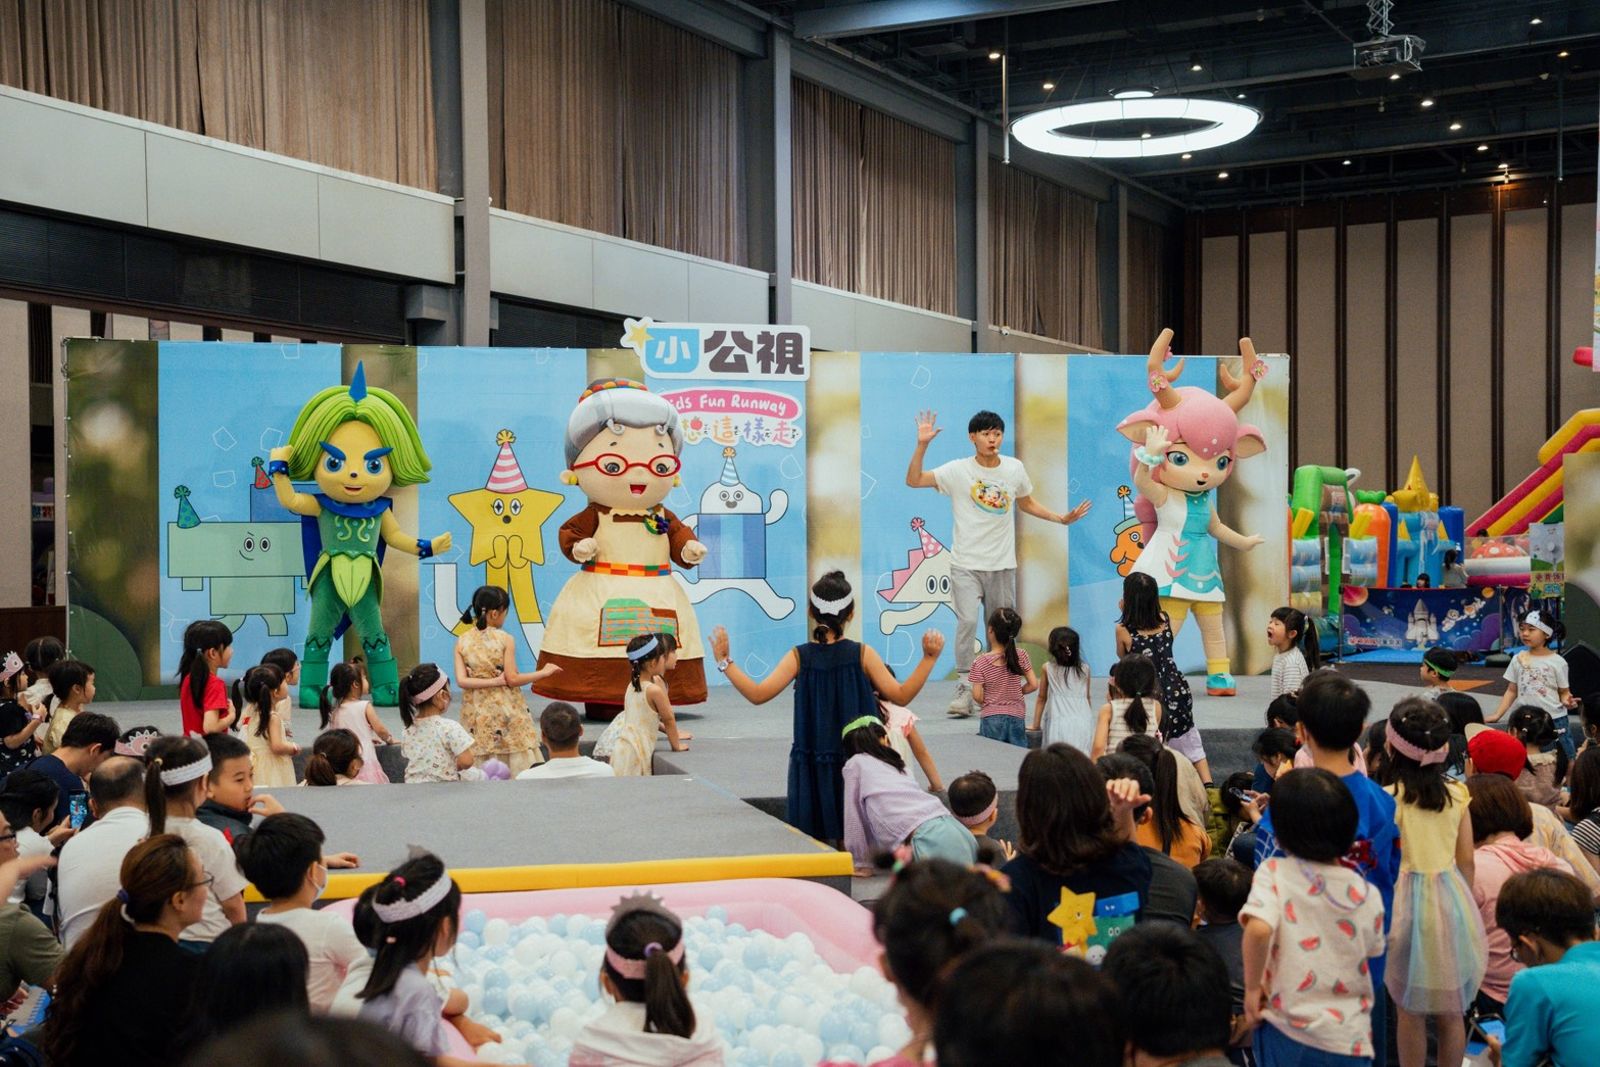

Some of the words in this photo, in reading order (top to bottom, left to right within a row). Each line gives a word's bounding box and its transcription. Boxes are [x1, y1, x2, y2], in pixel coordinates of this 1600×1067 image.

[654, 330, 805, 375] 小公視
[700, 394, 726, 409] Fun
[731, 394, 787, 417] Runway
